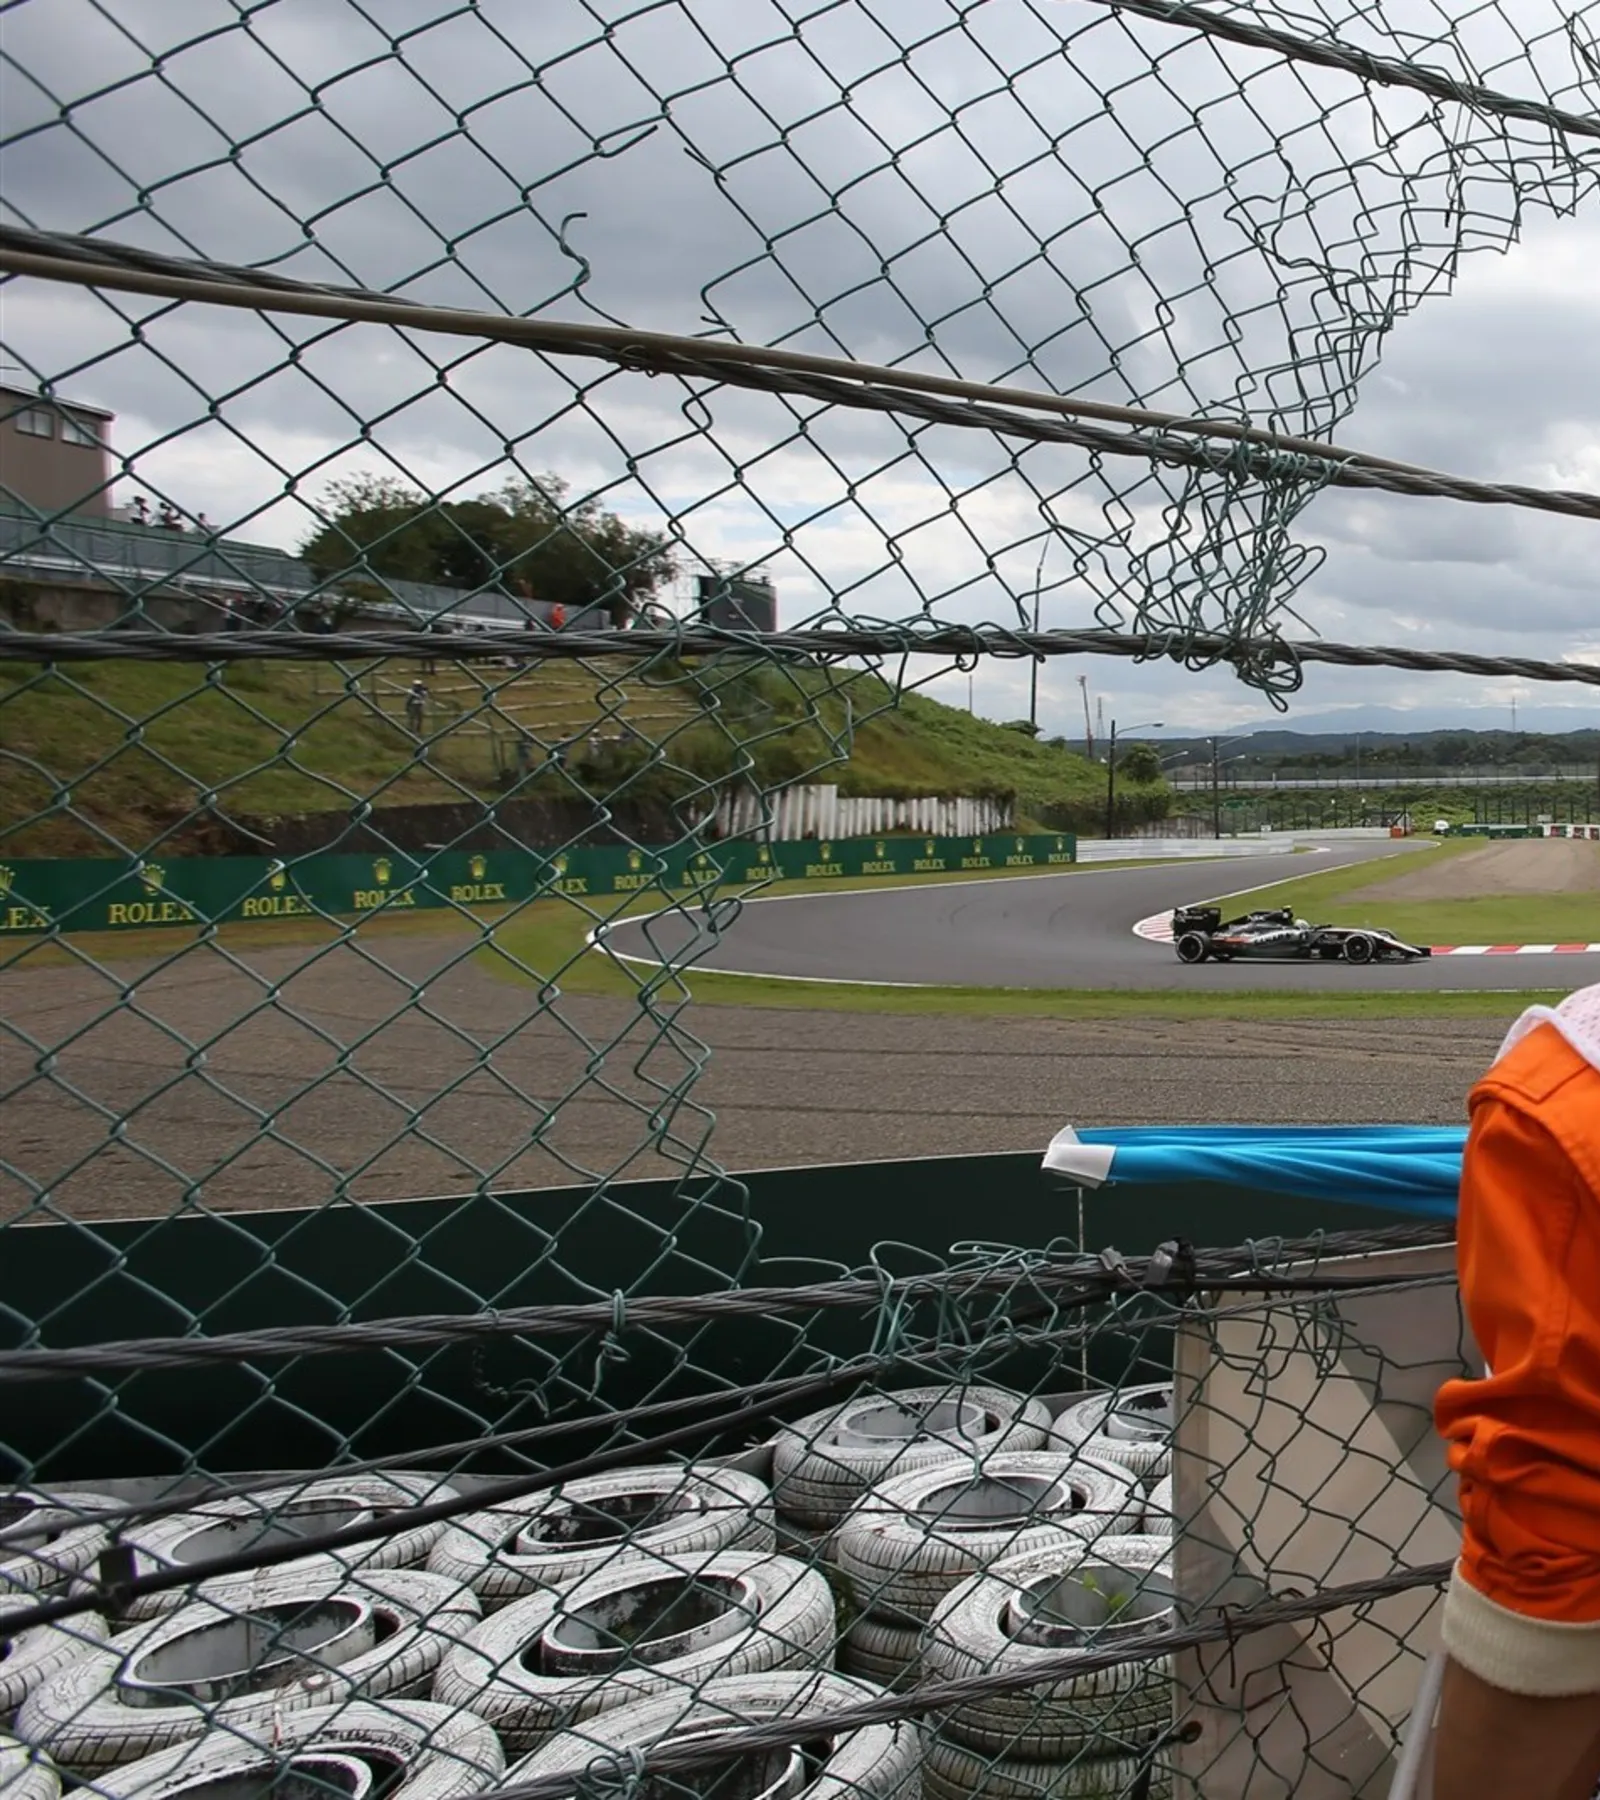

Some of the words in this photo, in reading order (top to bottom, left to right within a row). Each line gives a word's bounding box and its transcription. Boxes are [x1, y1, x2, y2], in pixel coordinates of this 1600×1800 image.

[862, 859, 895, 873] ROLEX
[914, 858, 945, 871] ROLEX
[961, 856, 990, 868] ROLEX
[1006, 854, 1033, 866] ROLEX
[806, 863, 843, 877] ROLEX
[354, 888, 415, 908] ROLEX
[451, 883, 505, 902] ROLEX
[108, 901, 194, 925] ROLEX
[242, 895, 313, 917] ROLEX
